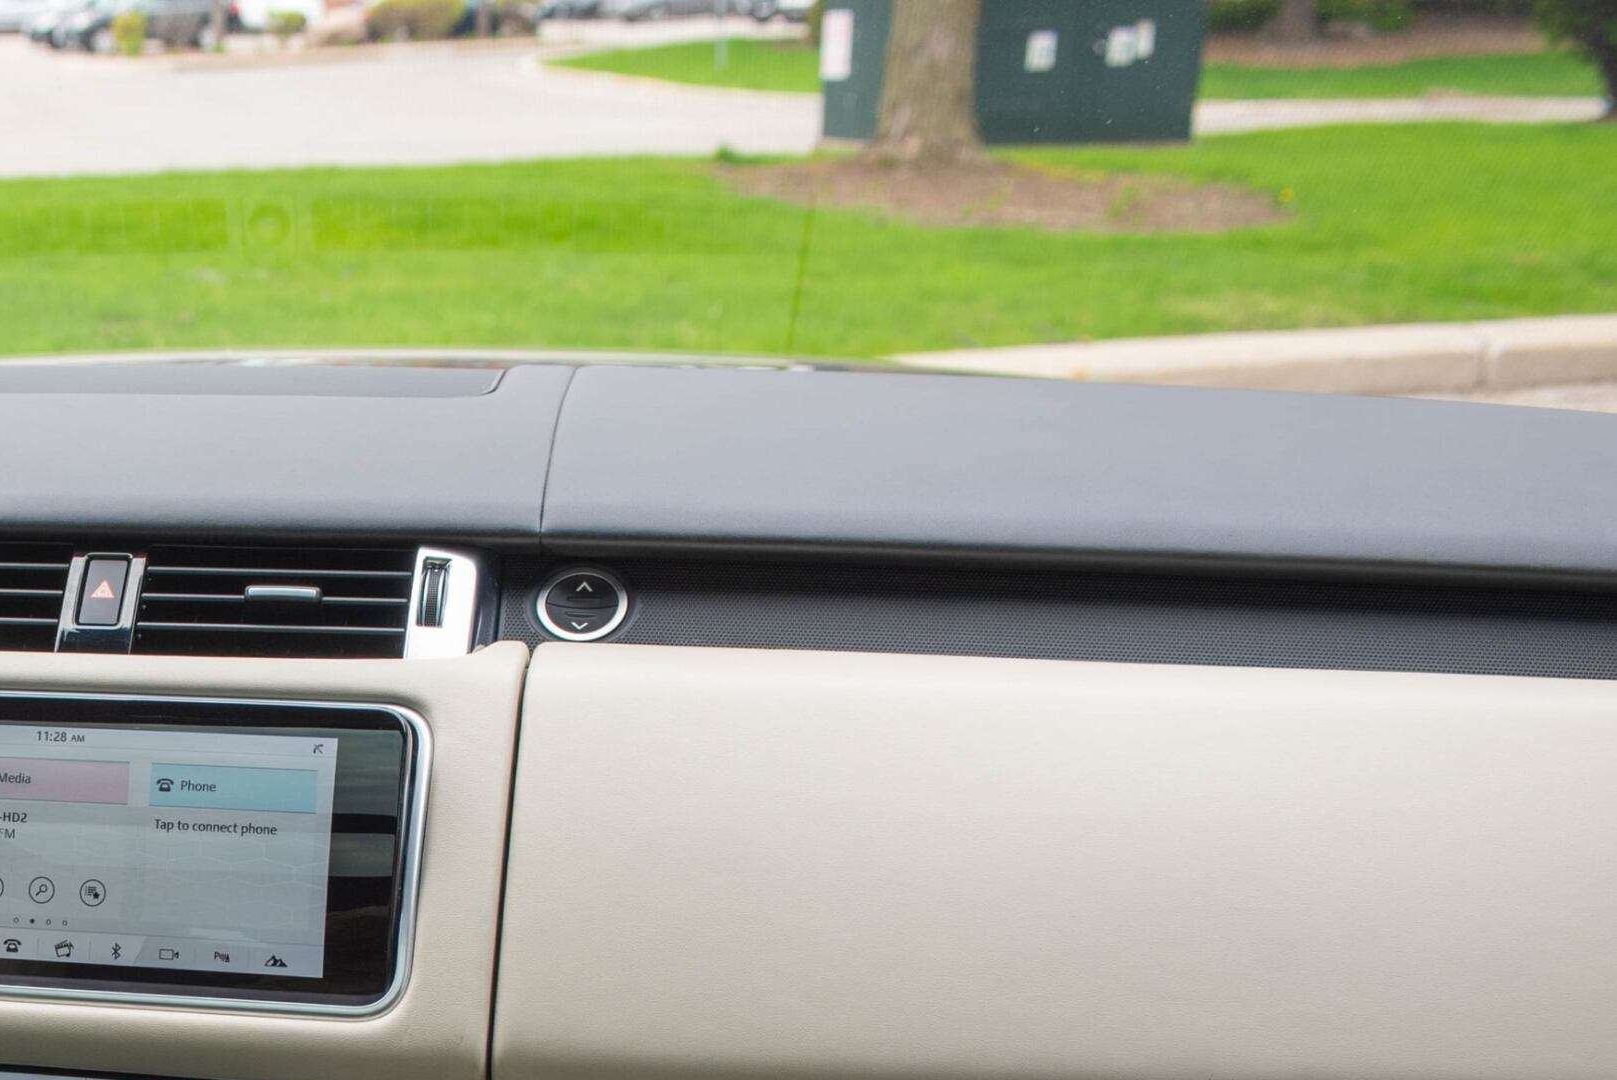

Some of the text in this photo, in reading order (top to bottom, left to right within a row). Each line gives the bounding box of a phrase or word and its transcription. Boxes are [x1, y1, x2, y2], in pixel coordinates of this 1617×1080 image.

[36, 730, 85, 743] 11:28 AM
[180, 780, 217, 792] Phone
[154, 818, 278, 836] Tap to connect phone
